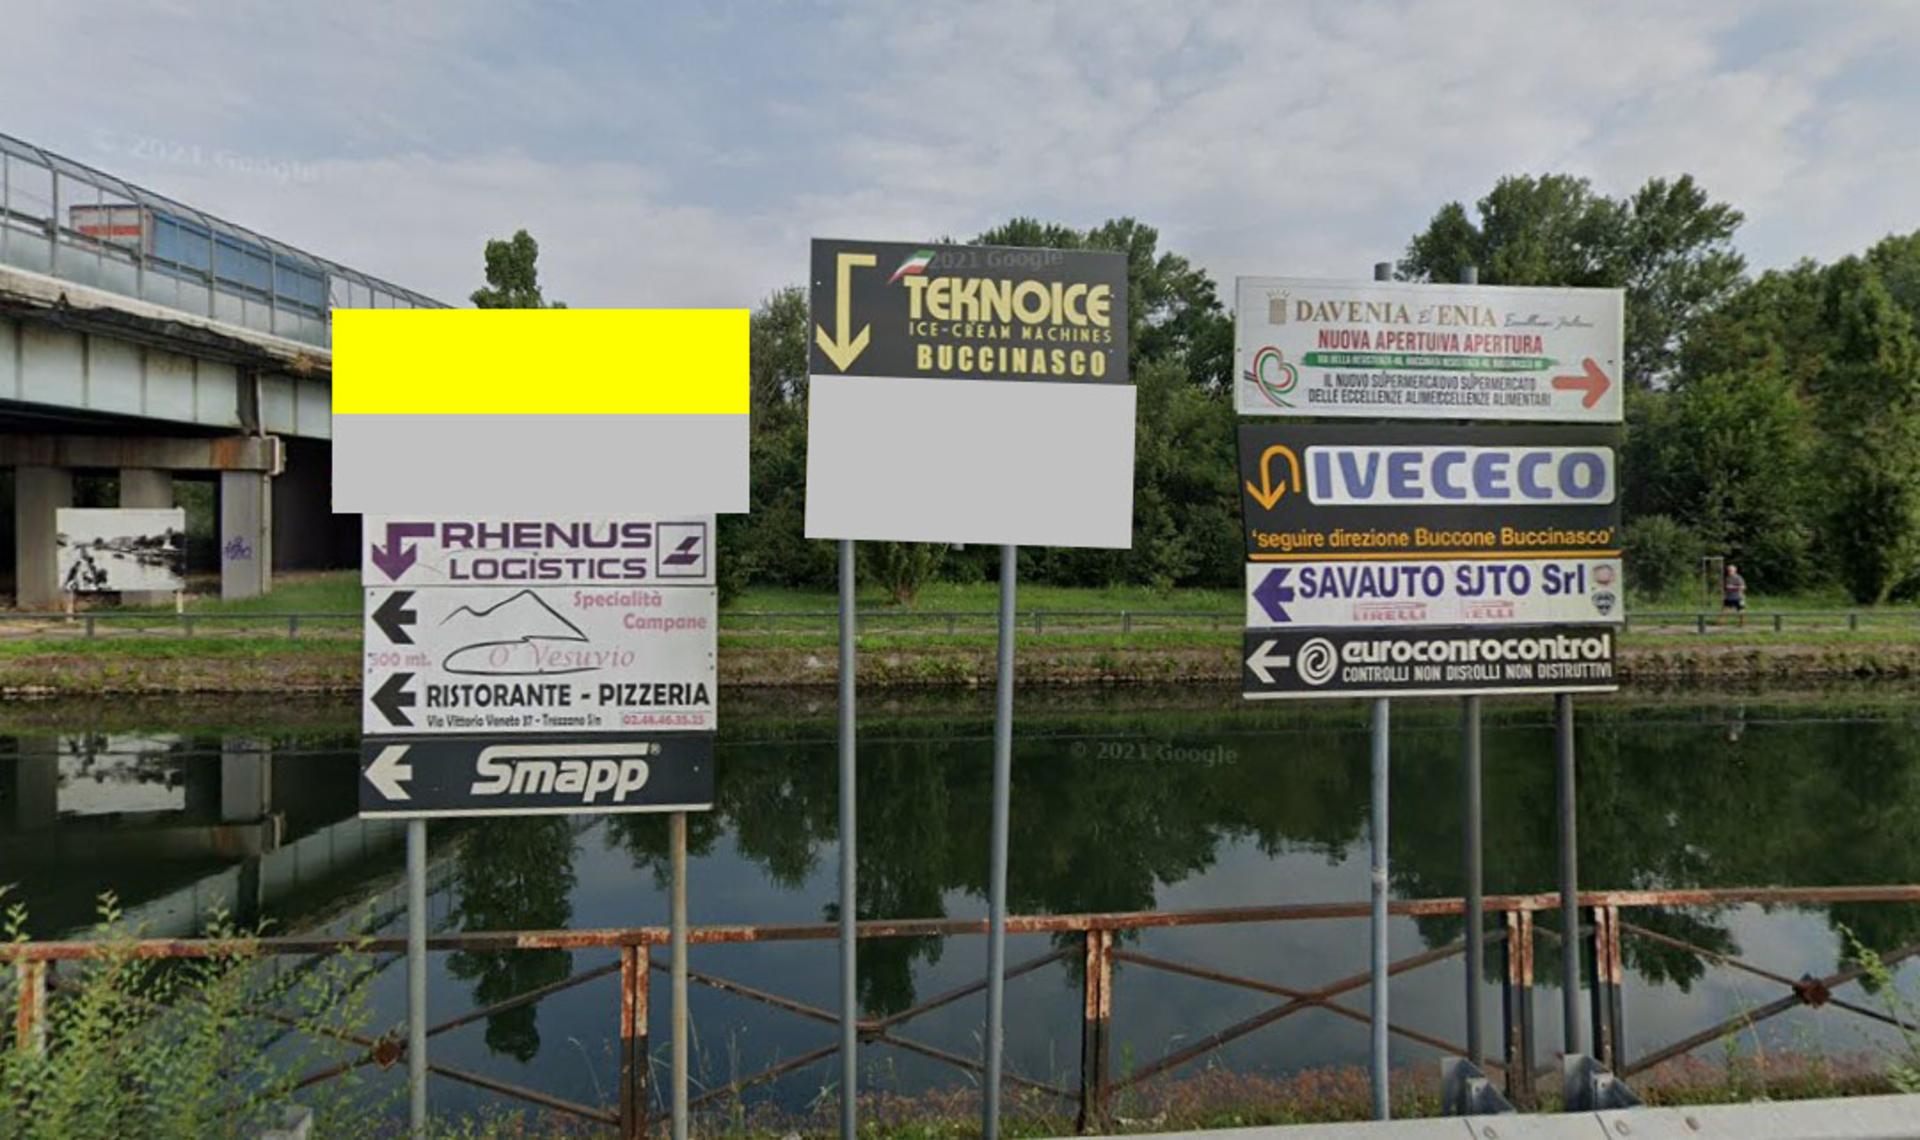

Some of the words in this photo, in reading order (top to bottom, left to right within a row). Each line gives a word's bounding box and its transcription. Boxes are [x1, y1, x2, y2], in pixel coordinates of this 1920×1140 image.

[903, 275, 1111, 327] TEKNOICE
[1296, 299, 1410, 324] DAVENIA
[1437, 305, 1497, 327] ENIA
[908, 321, 1011, 339] ICE-CREAM
[1021, 325, 1112, 343] MACHINES
[1318, 330, 1370, 350] NUOVA
[1463, 333, 1543, 354] APERTURA
[916, 343, 1106, 377] BUCCINASCO
[1308, 388, 1338, 403] DELLE
[1341, 389, 1403, 405] ECCELLENZE
[1313, 451, 1606, 499] IVECECO
[441, 522, 652, 549] RHENUS
[1328, 528, 1410, 547] direzione
[1415, 527, 1496, 546] Buccone
[450, 557, 647, 580] LOGISTICS
[1299, 565, 1444, 599] SAVAUTO
[1541, 563, 1585, 595] Srl
[573, 590, 663, 608] Specialità
[623, 613, 707, 632] Campane
[530, 643, 635, 668] Vesuvio
[1341, 634, 1611, 662] euroconrocontrol
[1342, 665, 1409, 682] CONTROLLI
[1414, 665, 1442, 682] NON
[1505, 663, 1533, 679] NON
[1537, 662, 1612, 679] DISTRUTTIVI
[426, 683, 571, 708] RISTORANTE
[600, 682, 711, 708] PIZZERIA
[427, 715, 444, 728] Via
[470, 742, 650, 803] Smapp
